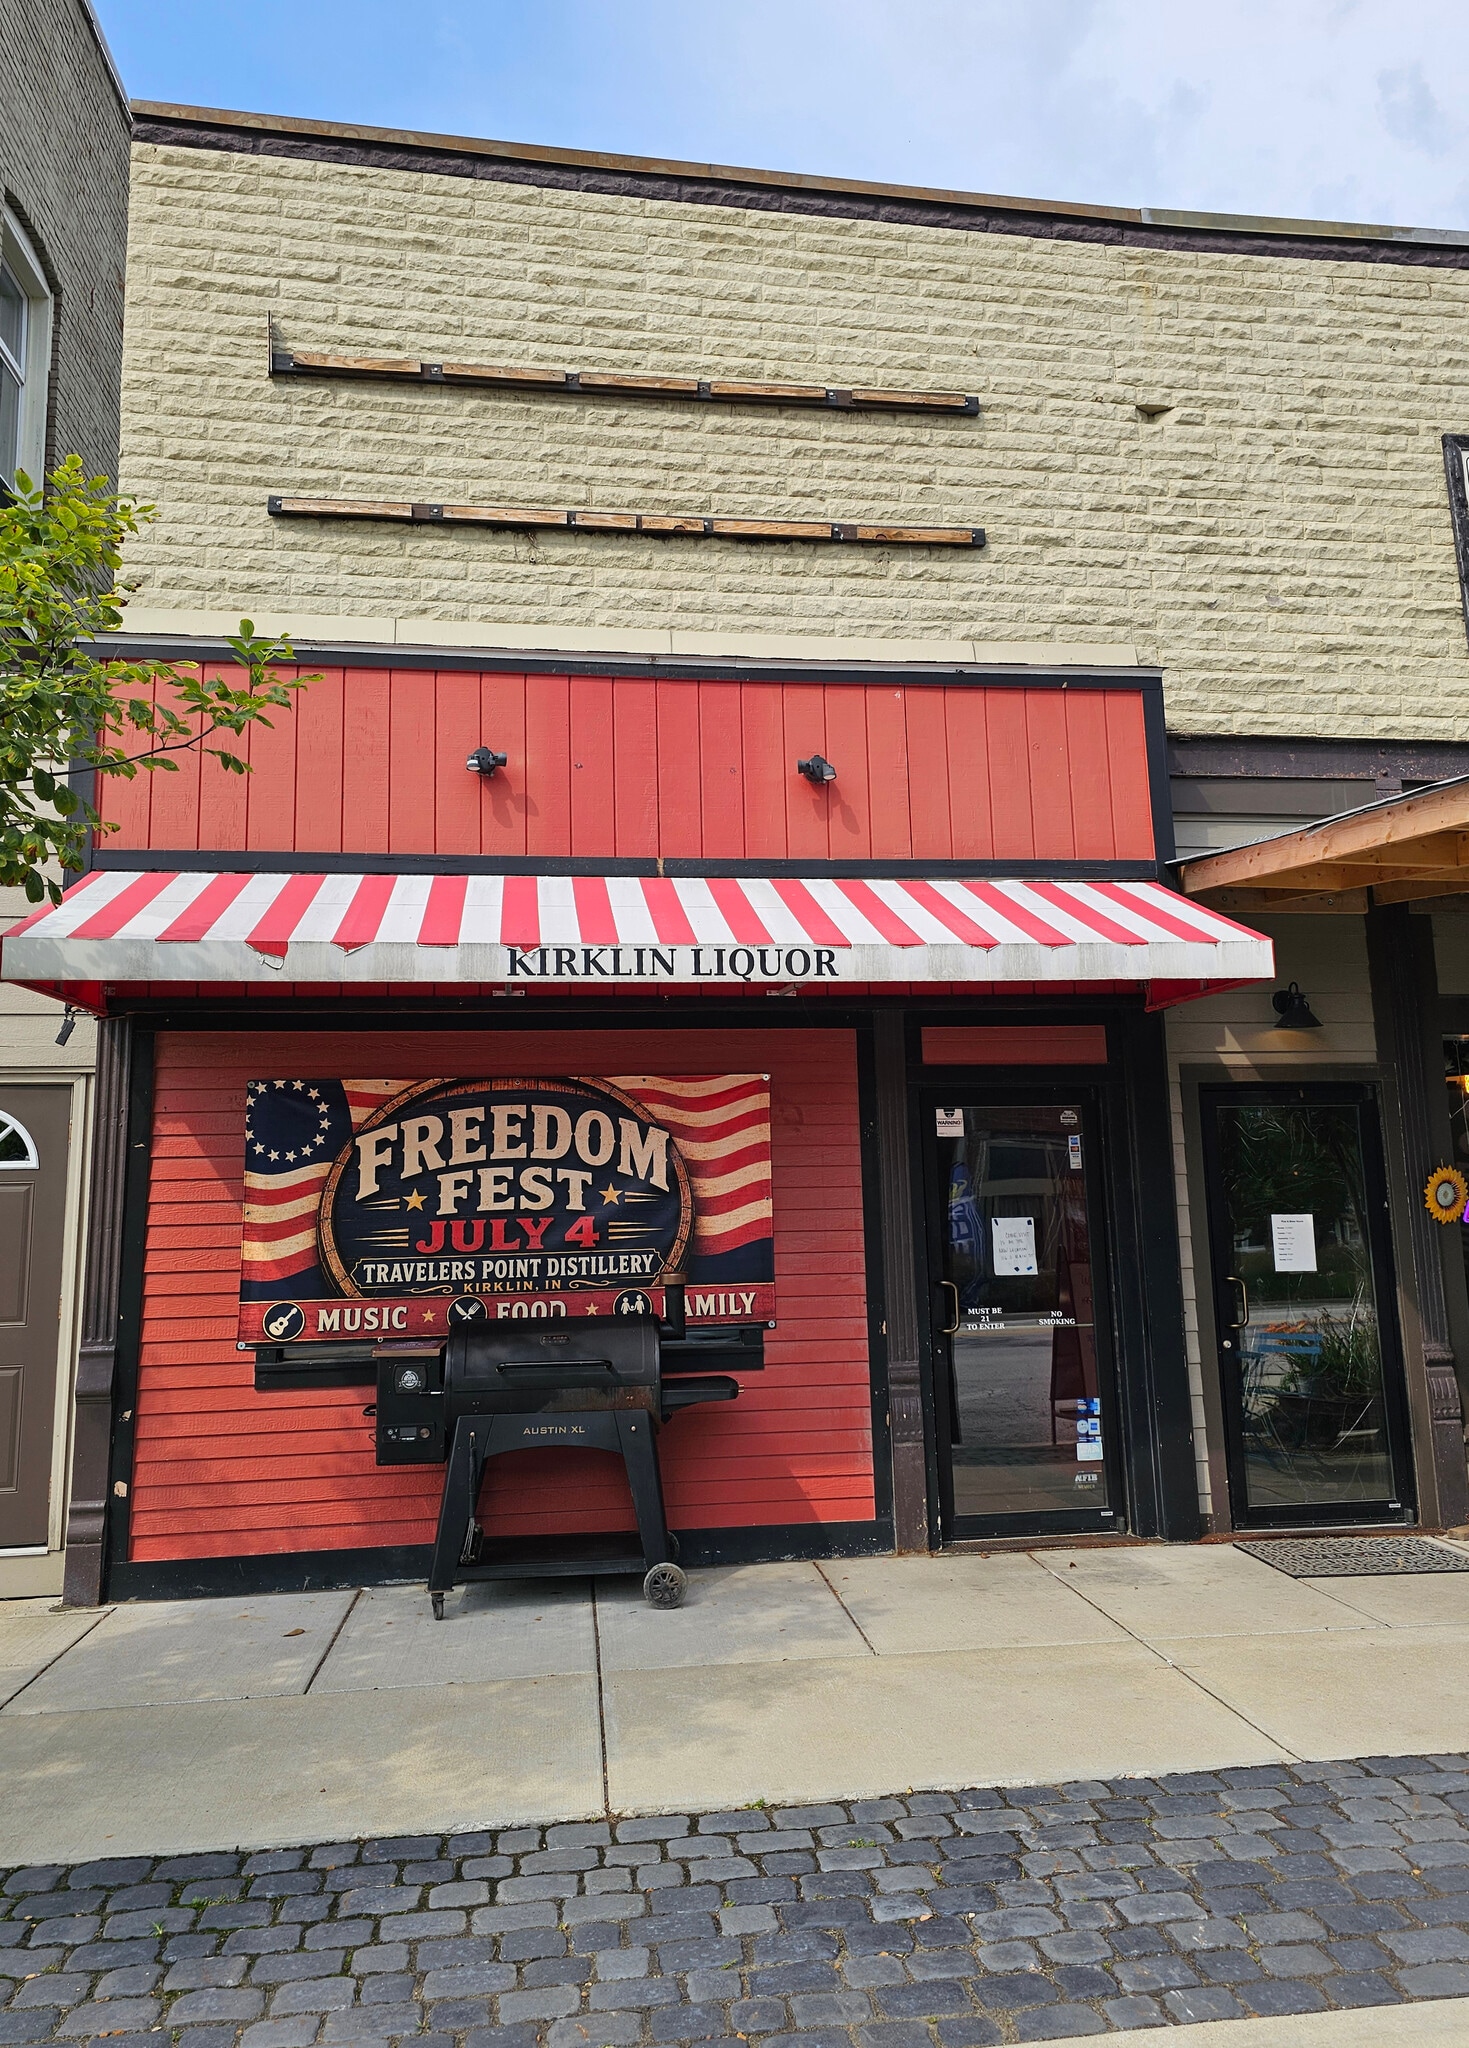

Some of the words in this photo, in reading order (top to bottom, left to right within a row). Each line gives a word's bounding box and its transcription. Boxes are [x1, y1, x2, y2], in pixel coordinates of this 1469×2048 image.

[506, 948, 676, 977] KIRKLIN
[690, 948, 839, 982] LIQUOR
[354, 1103, 670, 1202] FREEDOM
[435, 1167, 594, 1216] FEST
[415, 1217, 553, 1254] JULY
[564, 1215, 600, 1248] 4
[362, 1261, 475, 1284] TRAVELERS
[481, 1257, 540, 1280] POINT
[545, 1253, 655, 1276] DISTILLERY
[463, 1281, 539, 1293] KIRKLIN,
[545, 1279, 561, 1290] IN
[317, 1306, 407, 1332] MUSIC
[497, 1300, 567, 1320] FOOD
[662, 1292, 756, 1318] AMILY
[966, 1323, 978, 1331] TO
[979, 1322, 1005, 1330] ENTER
[967, 1307, 990, 1315] MUST
[991, 1307, 1003, 1315] BE
[1050, 1310, 1063, 1318] NO
[522, 1426, 567, 1435] AUSTIN
[570, 1425, 585, 1433] XL
